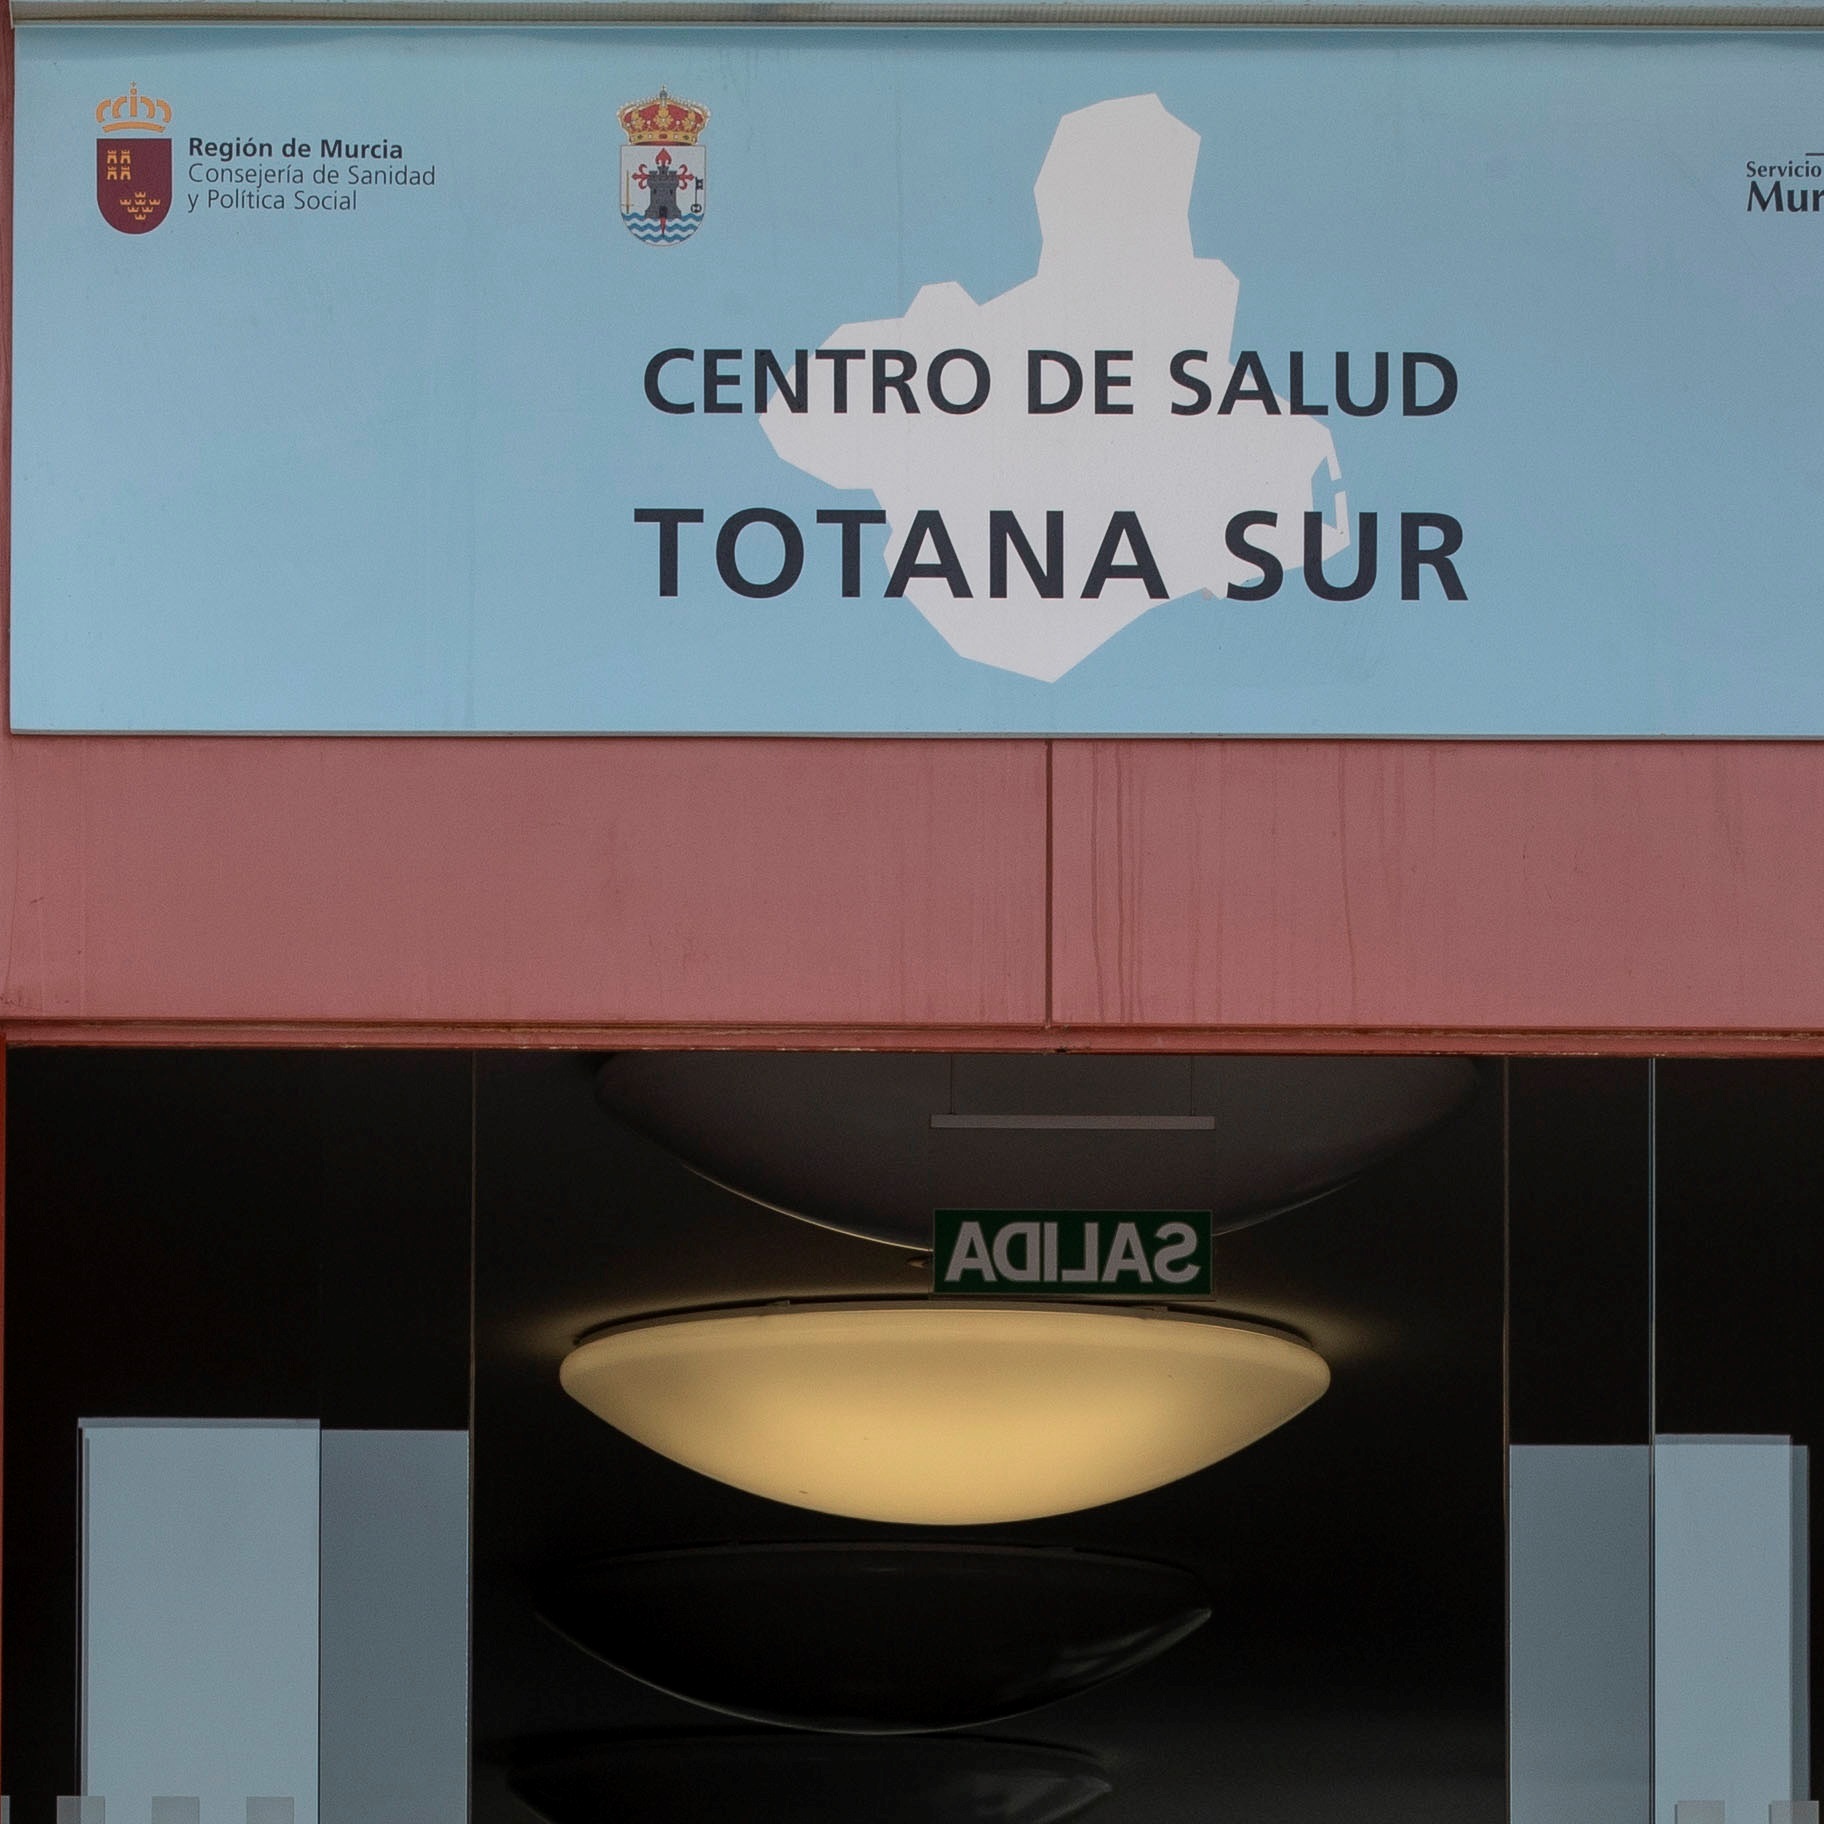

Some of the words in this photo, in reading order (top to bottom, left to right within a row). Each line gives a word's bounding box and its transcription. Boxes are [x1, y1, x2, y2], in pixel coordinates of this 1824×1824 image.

[189, 137, 273, 162] Región
[282, 138, 311, 158] de
[320, 139, 403, 159] Murcia
[188, 163, 304, 188] Consejería
[312, 164, 340, 185] de
[348, 165, 436, 186] Sanidad
[1746, 160, 1822, 178] Servicio
[188, 193, 199, 213] y
[208, 189, 285, 210] Política
[294, 190, 357, 210] Social
[643, 347, 991, 416] CENTRO
[1028, 349, 1134, 415] DE
[1169, 349, 1459, 417] SALUD
[634, 507, 1170, 600] TOTANA
[1224, 510, 1469, 602] SUR
